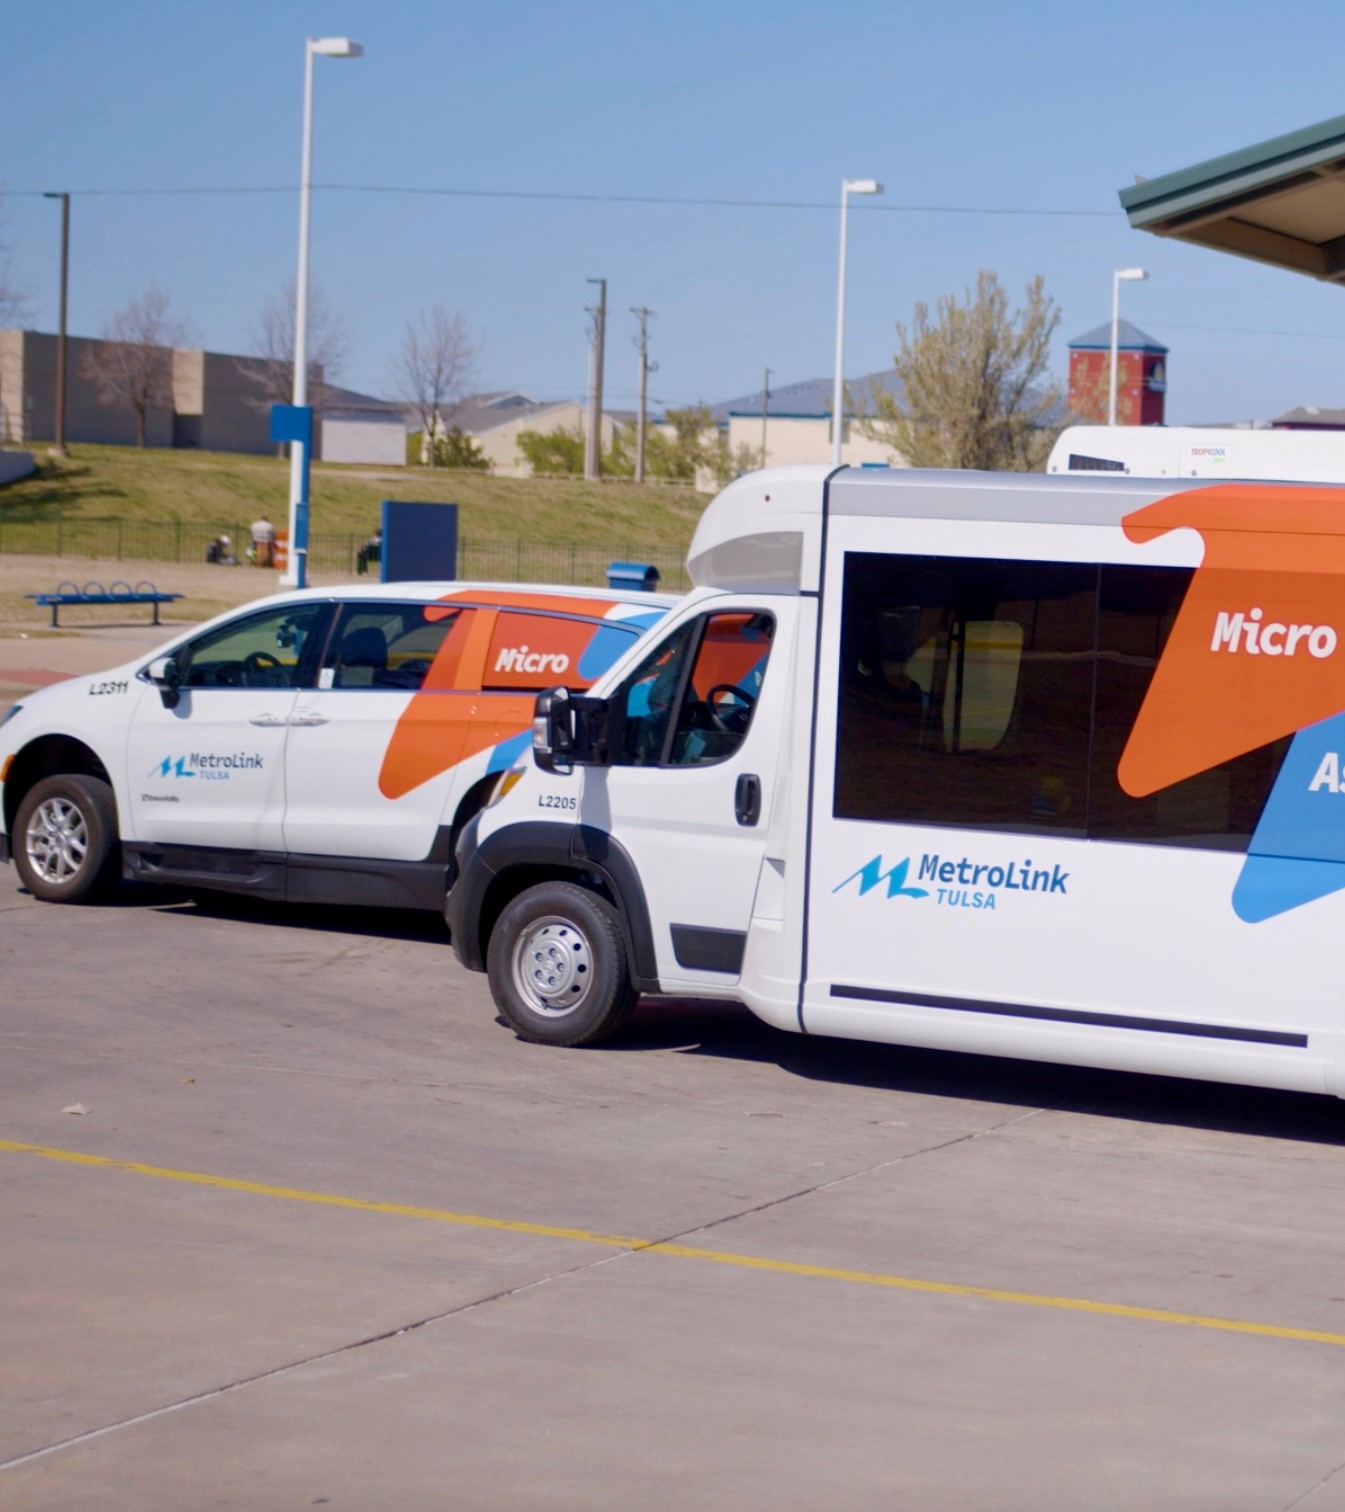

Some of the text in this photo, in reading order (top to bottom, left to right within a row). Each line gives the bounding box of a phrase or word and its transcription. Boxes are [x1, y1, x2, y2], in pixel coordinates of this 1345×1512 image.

[1210, 608, 1338, 659] Micro
[494, 645, 569, 673] Micro
[88, 681, 129, 695] L2311
[189, 752, 264, 769] MetroLink
[200, 770, 230, 780] TULSA
[538, 795, 577, 809] L2205
[918, 854, 1070, 894] MetroLink
[936, 888, 996, 909] TULSA
